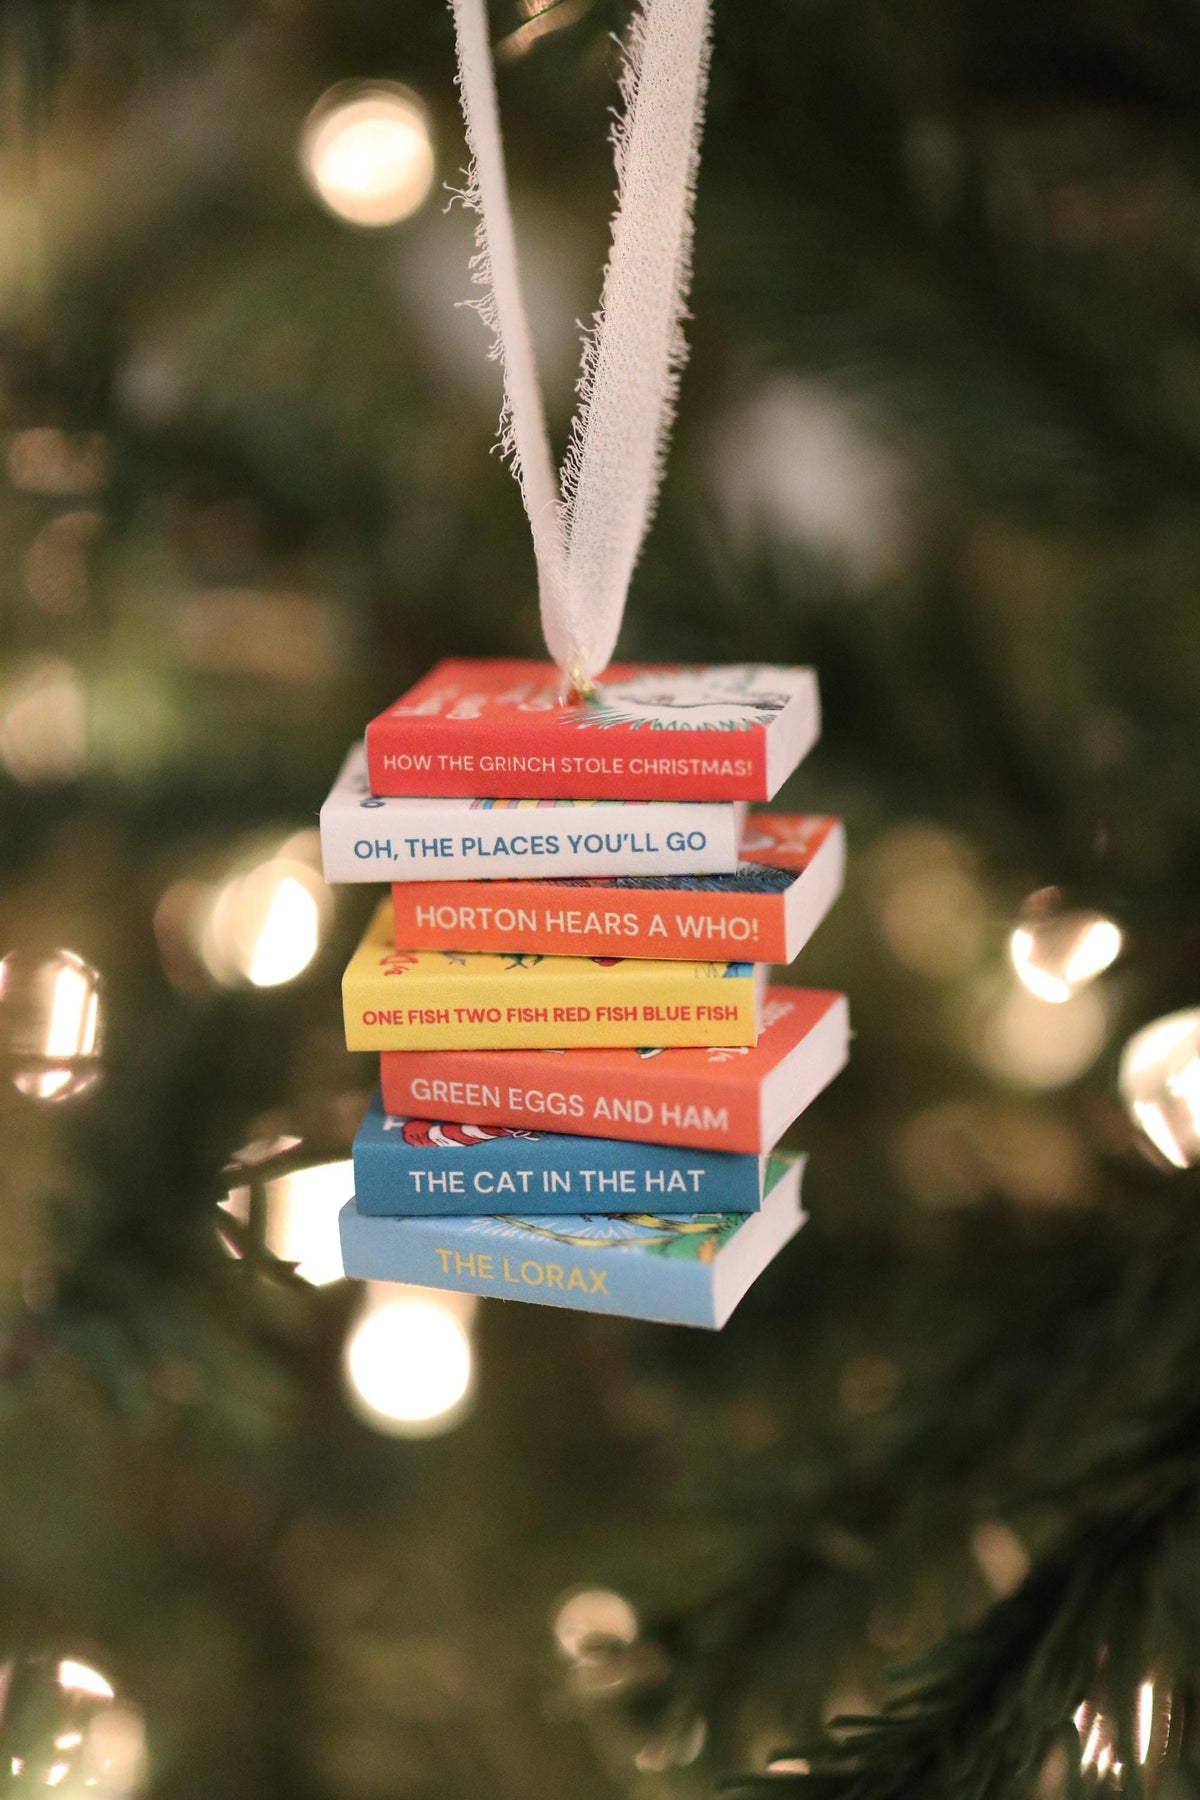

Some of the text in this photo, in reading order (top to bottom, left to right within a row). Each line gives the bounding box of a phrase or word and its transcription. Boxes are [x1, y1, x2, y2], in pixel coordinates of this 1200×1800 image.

[384, 755, 752, 776] HOW THE GRINCH STOLE CHRISTMAS!
[354, 831, 706, 862] OH, THE PLACES YOU'LL GO
[416, 905, 759, 941] HORTON HEARS A WHO!
[363, 1006, 738, 1026] ONE FISH TWO FISH RED FISH BLUE FISH
[411, 1078, 728, 1131] GREEN EGGS AND HAM
[409, 1170, 704, 1193] THE CAT IN THE HAT
[436, 1247, 608, 1295] THE LORAX
